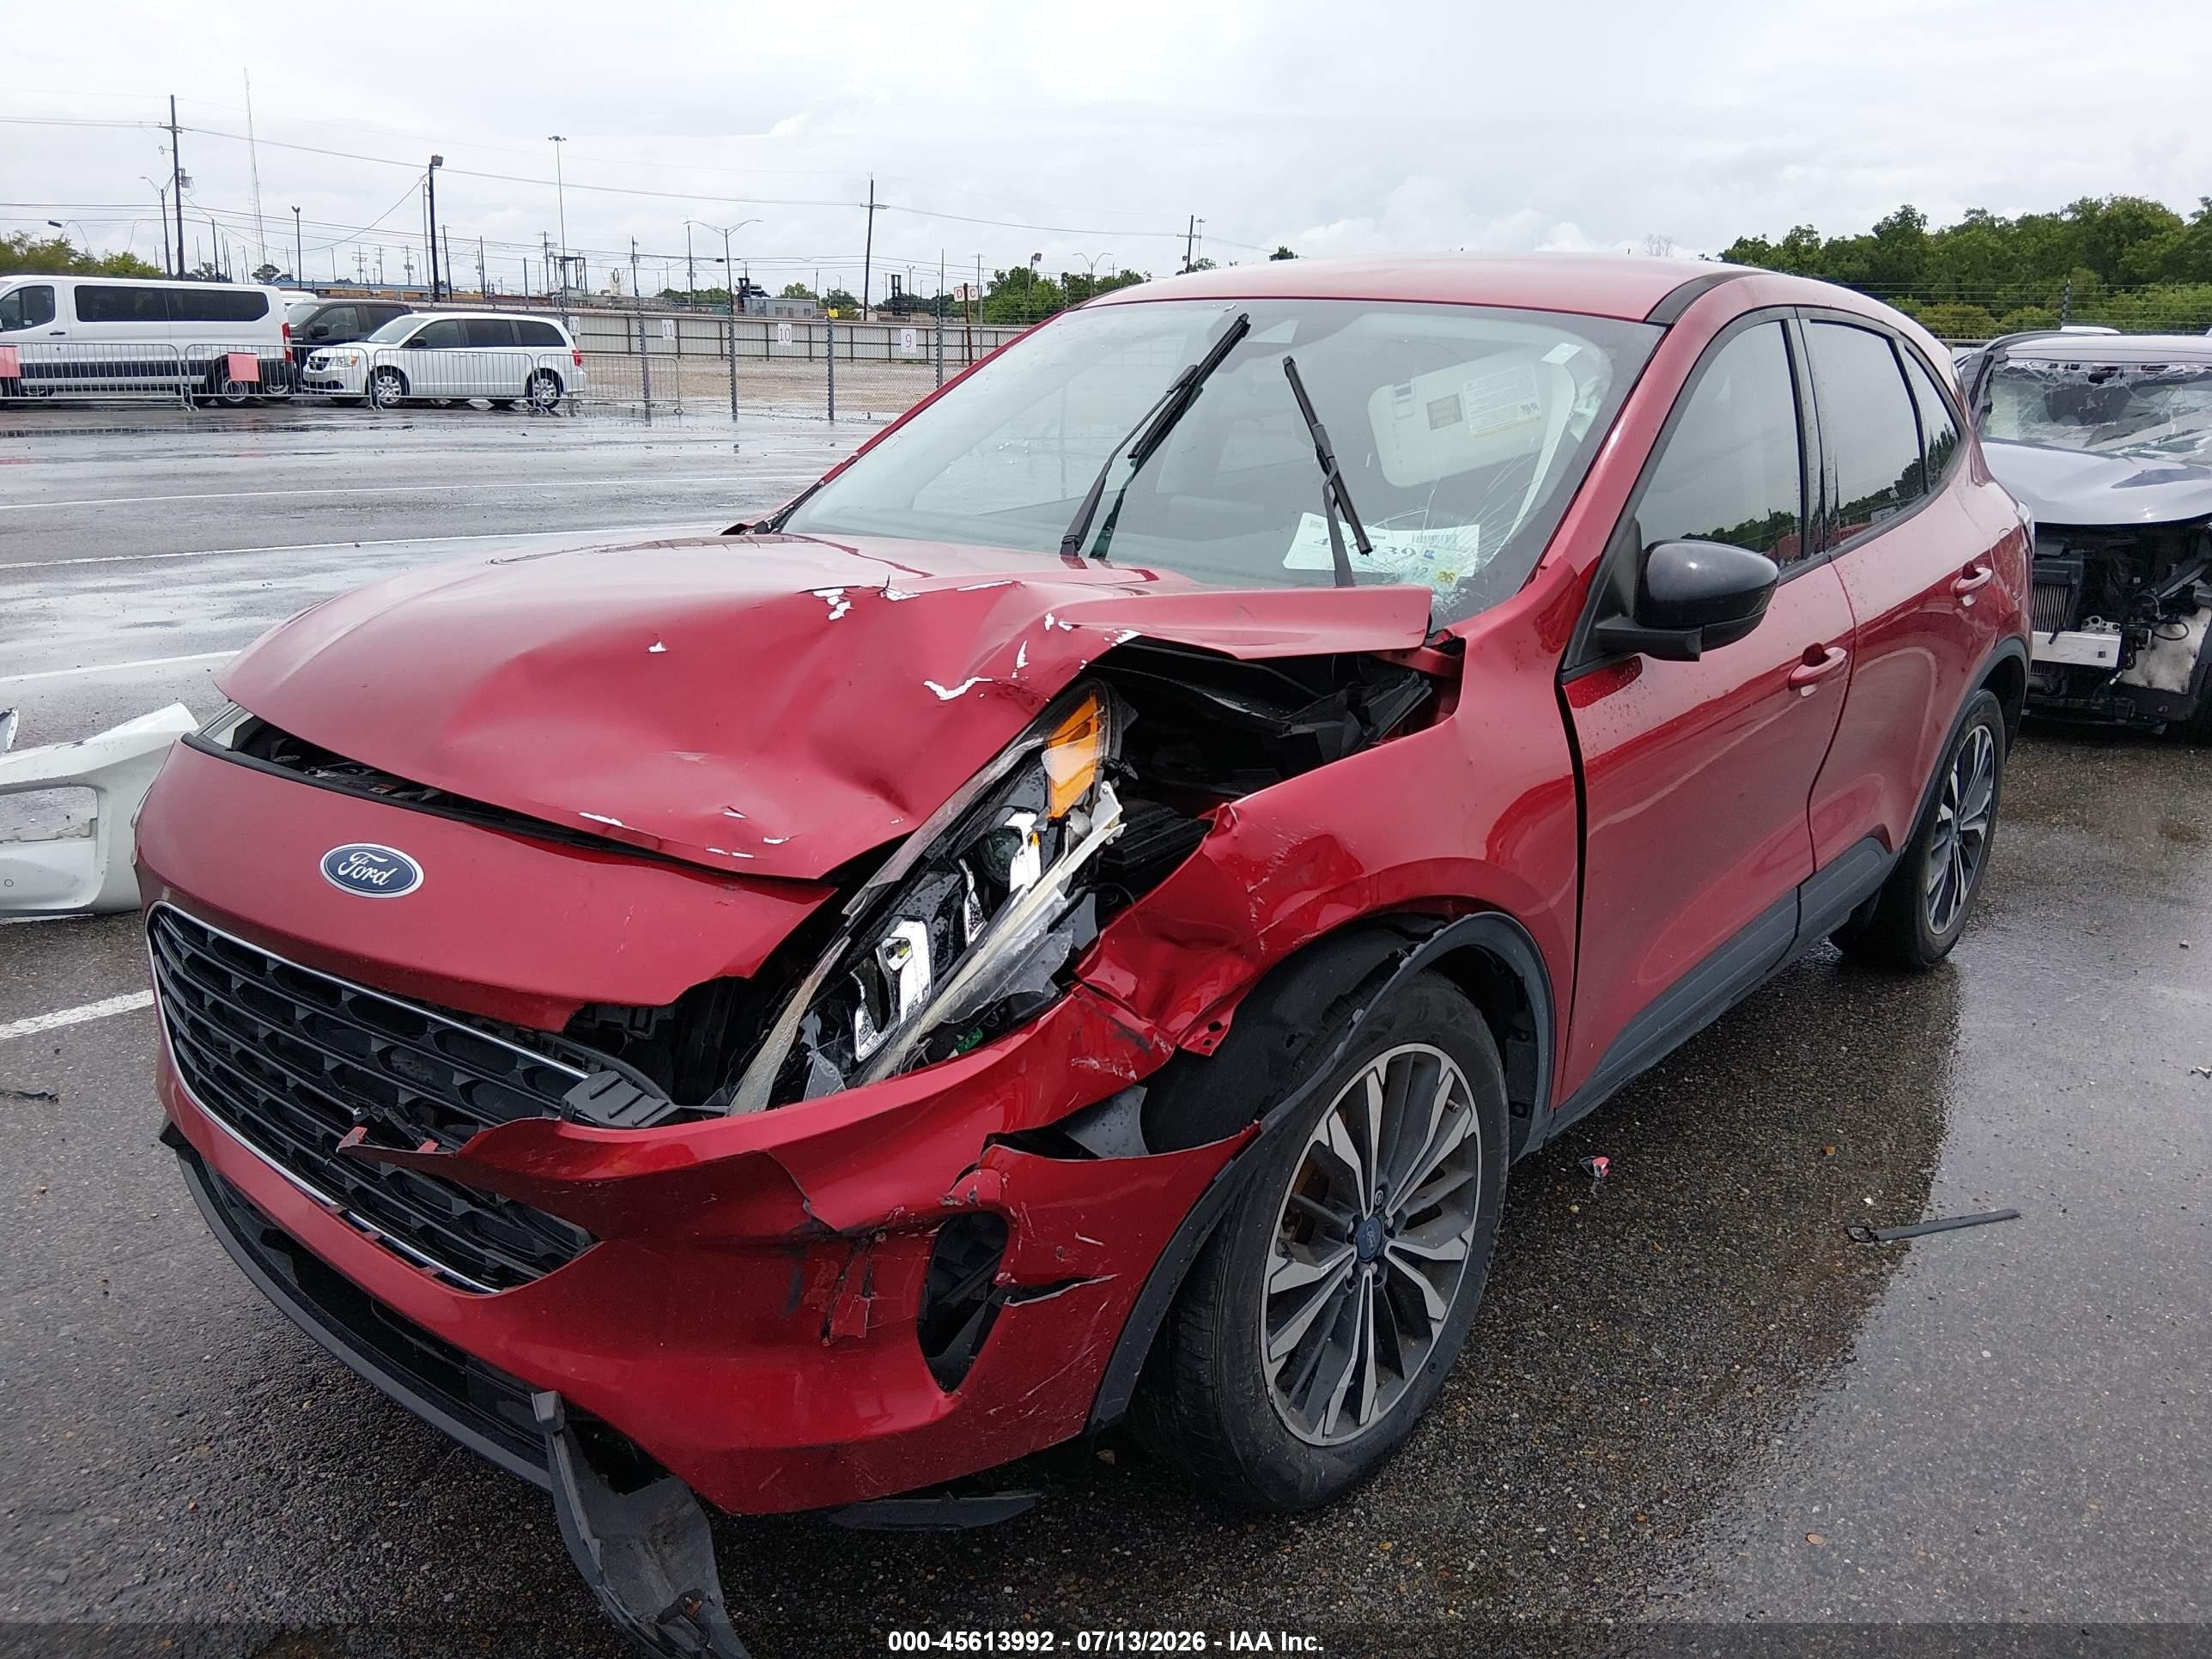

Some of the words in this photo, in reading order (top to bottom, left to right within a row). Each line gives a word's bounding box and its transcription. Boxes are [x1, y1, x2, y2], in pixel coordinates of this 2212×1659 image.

[969, 289, 975, 298] C
[570, 319, 580, 332] 12
[663, 324, 674, 337] 11
[779, 328, 791, 342] 10
[905, 333, 912, 348] 9
[337, 851, 398, 886] Ford
